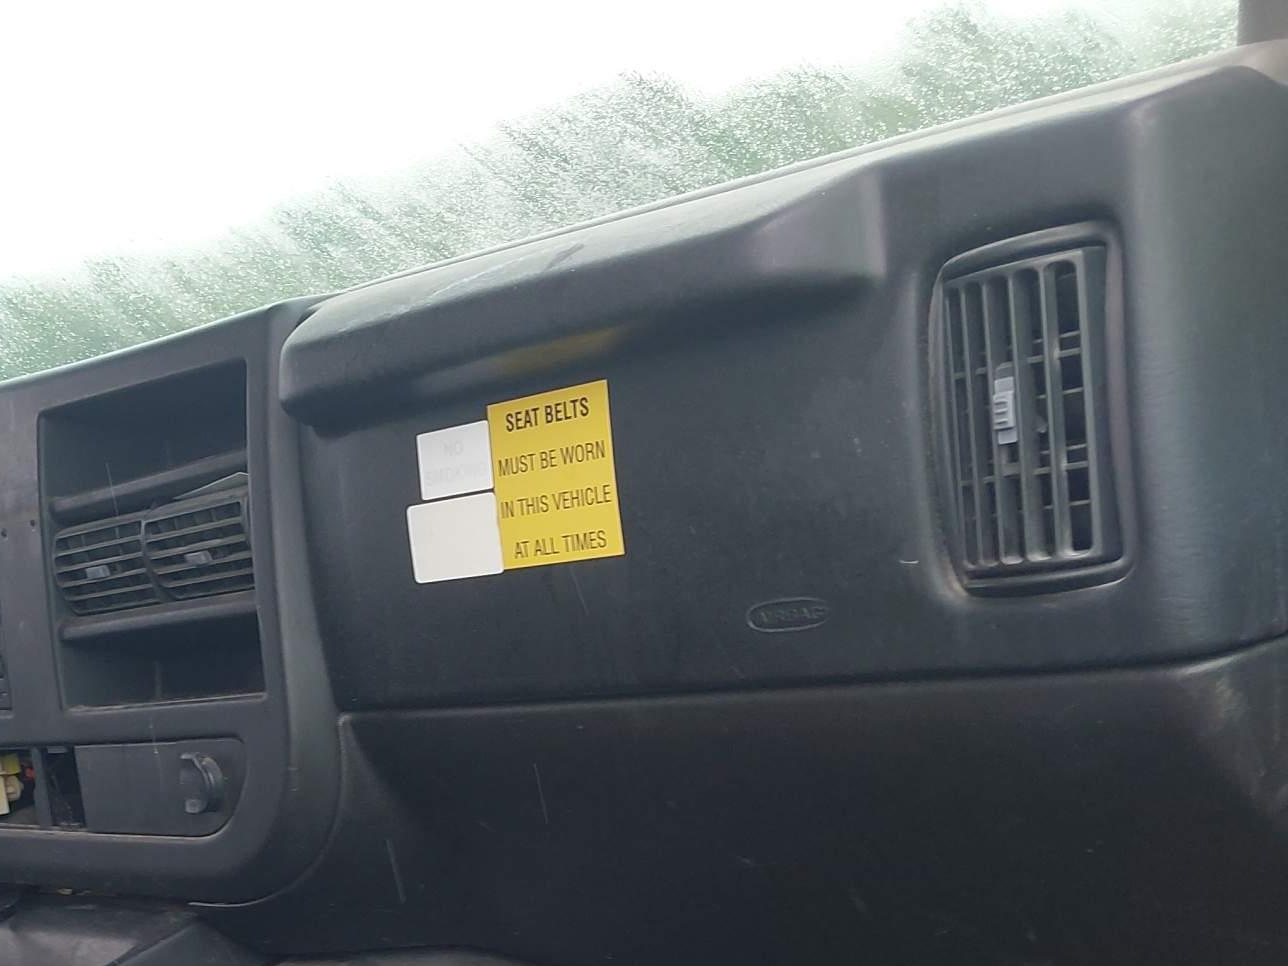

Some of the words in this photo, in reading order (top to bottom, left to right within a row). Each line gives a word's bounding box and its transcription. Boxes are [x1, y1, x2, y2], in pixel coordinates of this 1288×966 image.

[505, 407, 540, 432] SEAT
[545, 397, 590, 424] BELTS
[498, 453, 536, 477] MUST
[540, 450, 557, 469] BE
[560, 440, 606, 465] WORN
[501, 499, 516, 519] IN
[517, 492, 549, 515] THIS
[552, 484, 612, 511] VEHICLE
[514, 540, 530, 559] AT
[534, 537, 560, 557] ALL
[562, 530, 608, 552] TIMES
